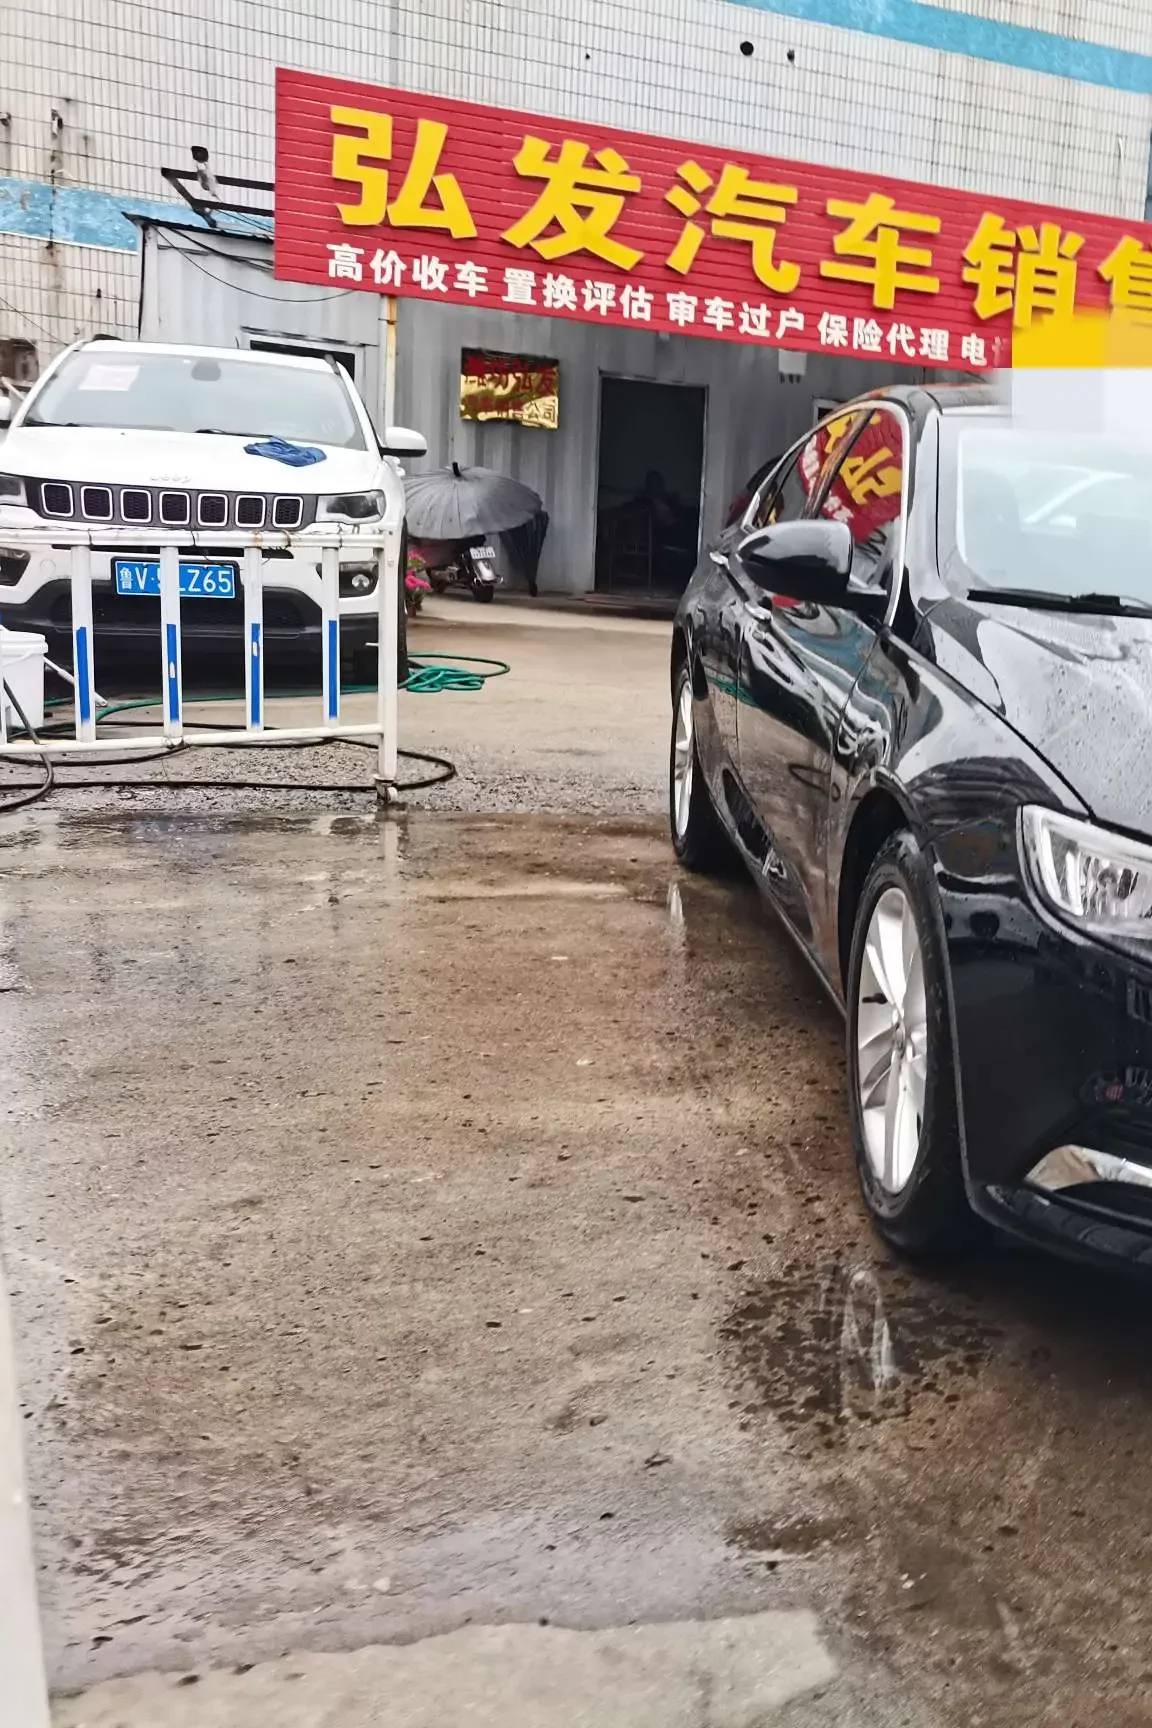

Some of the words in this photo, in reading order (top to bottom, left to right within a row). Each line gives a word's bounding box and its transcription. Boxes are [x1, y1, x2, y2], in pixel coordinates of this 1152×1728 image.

[326, 243, 488, 297] 高价收车
[501, 267, 654, 321] 置换评估
[666, 291, 805, 339] 审车过户
[817, 311, 949, 362] 保险代理
